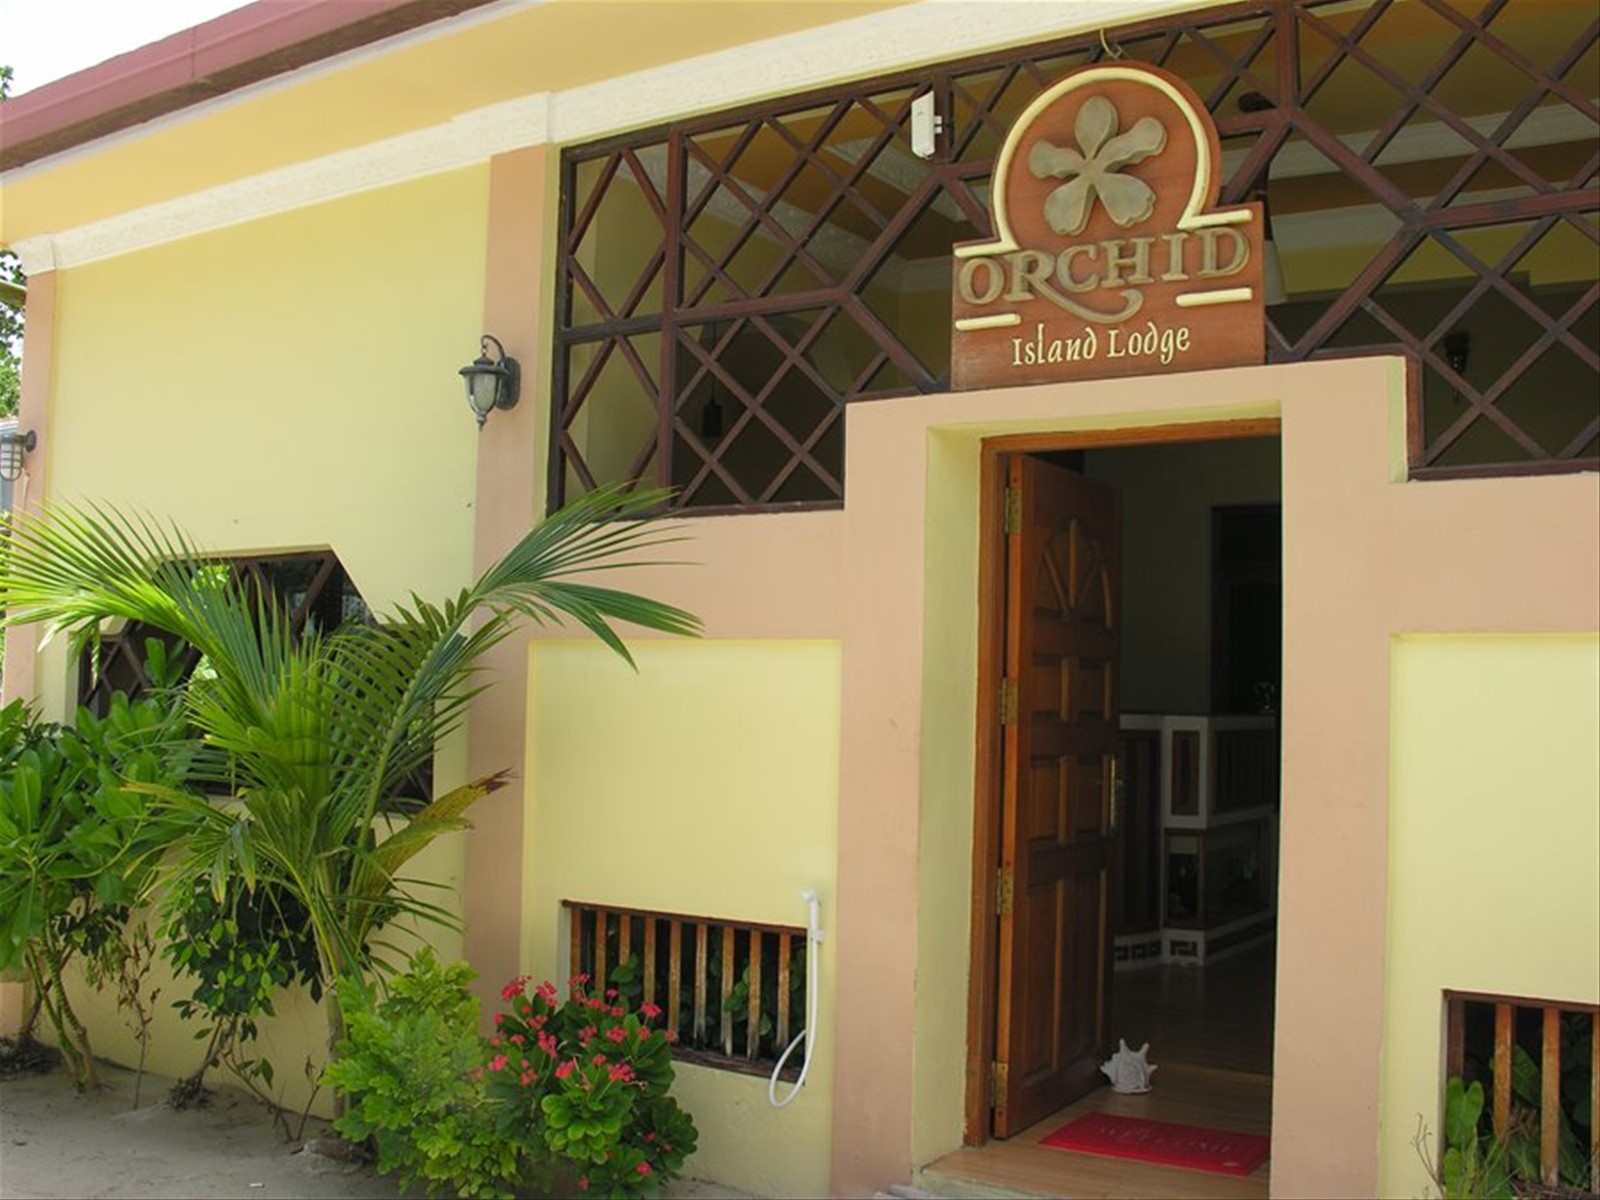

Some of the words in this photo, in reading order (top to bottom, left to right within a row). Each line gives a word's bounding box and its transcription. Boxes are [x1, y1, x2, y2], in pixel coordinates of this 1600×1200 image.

[959, 227, 1250, 323] ORCHID
[1012, 323, 1097, 365] Island
[1107, 322, 1190, 364] Lodge
